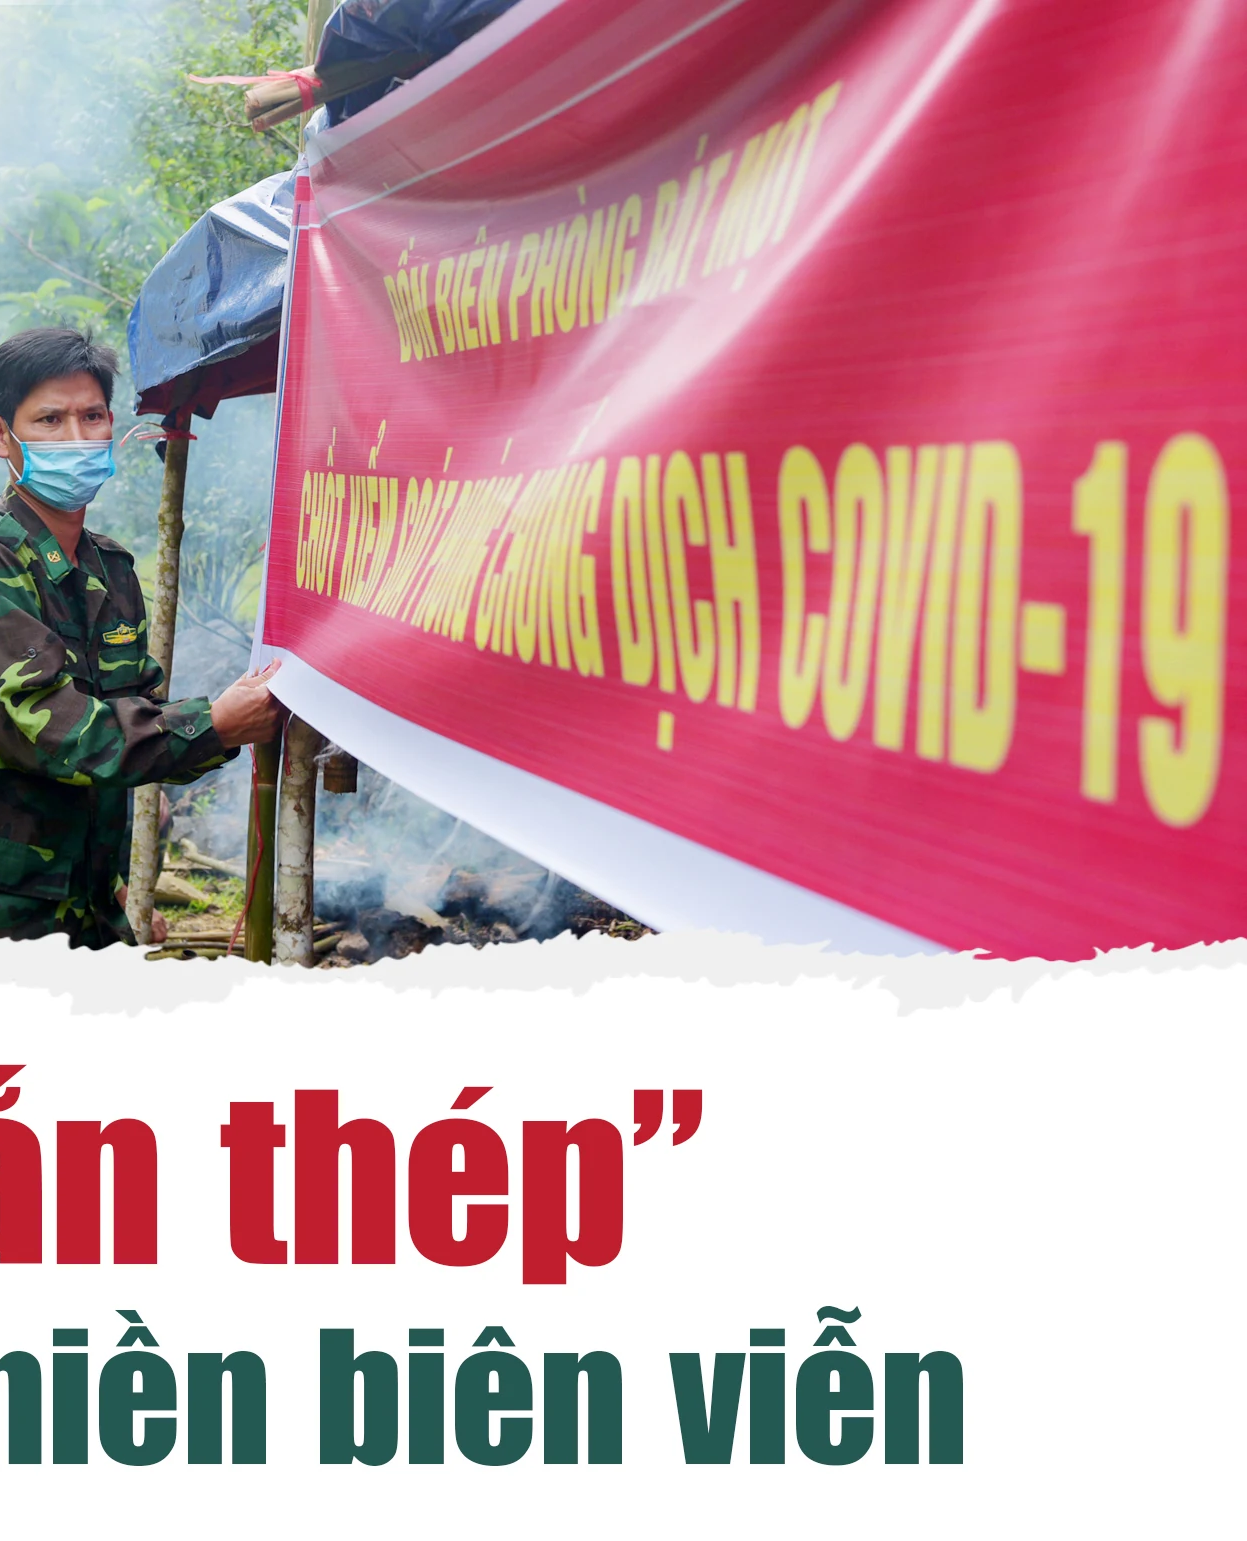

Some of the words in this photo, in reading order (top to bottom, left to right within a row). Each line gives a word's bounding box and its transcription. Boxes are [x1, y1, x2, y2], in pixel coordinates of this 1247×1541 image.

[435, 225, 510, 354] BIÊN
[509, 185, 642, 341] PHÒNG
[630, 133, 733, 307] BÁT
[295, 427, 345, 597] CHỐT
[338, 419, 399, 609] KIỂM
[369, 447, 459, 622] SOÁT
[611, 450, 760, 752] DỊCH
[777, 431, 1229, 829] COVID-19
